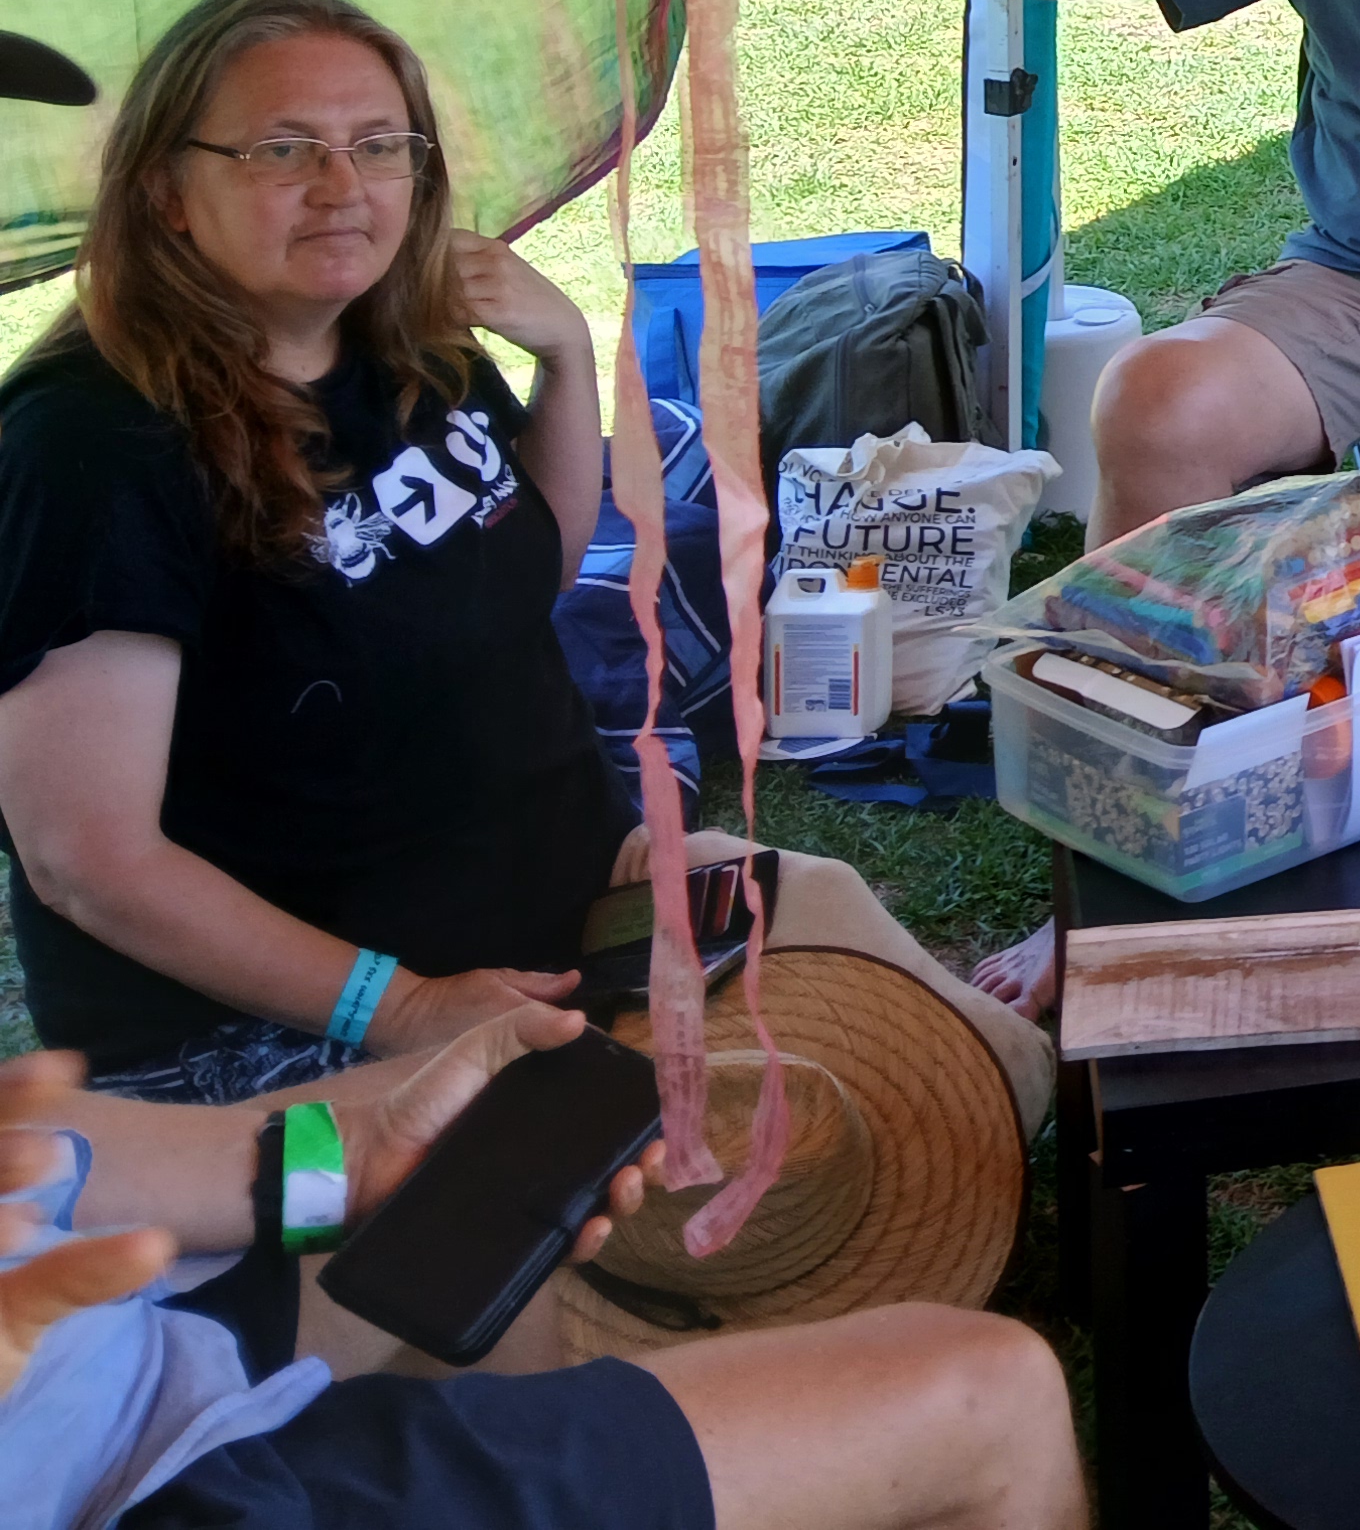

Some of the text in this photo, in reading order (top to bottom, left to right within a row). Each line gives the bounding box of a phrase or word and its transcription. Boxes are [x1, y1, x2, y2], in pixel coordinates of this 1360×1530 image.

[880, 512, 941, 524] ANYONE
[944, 513, 976, 524] CAN
[793, 519, 976, 556] FUTURE
[944, 555, 976, 568] THE
